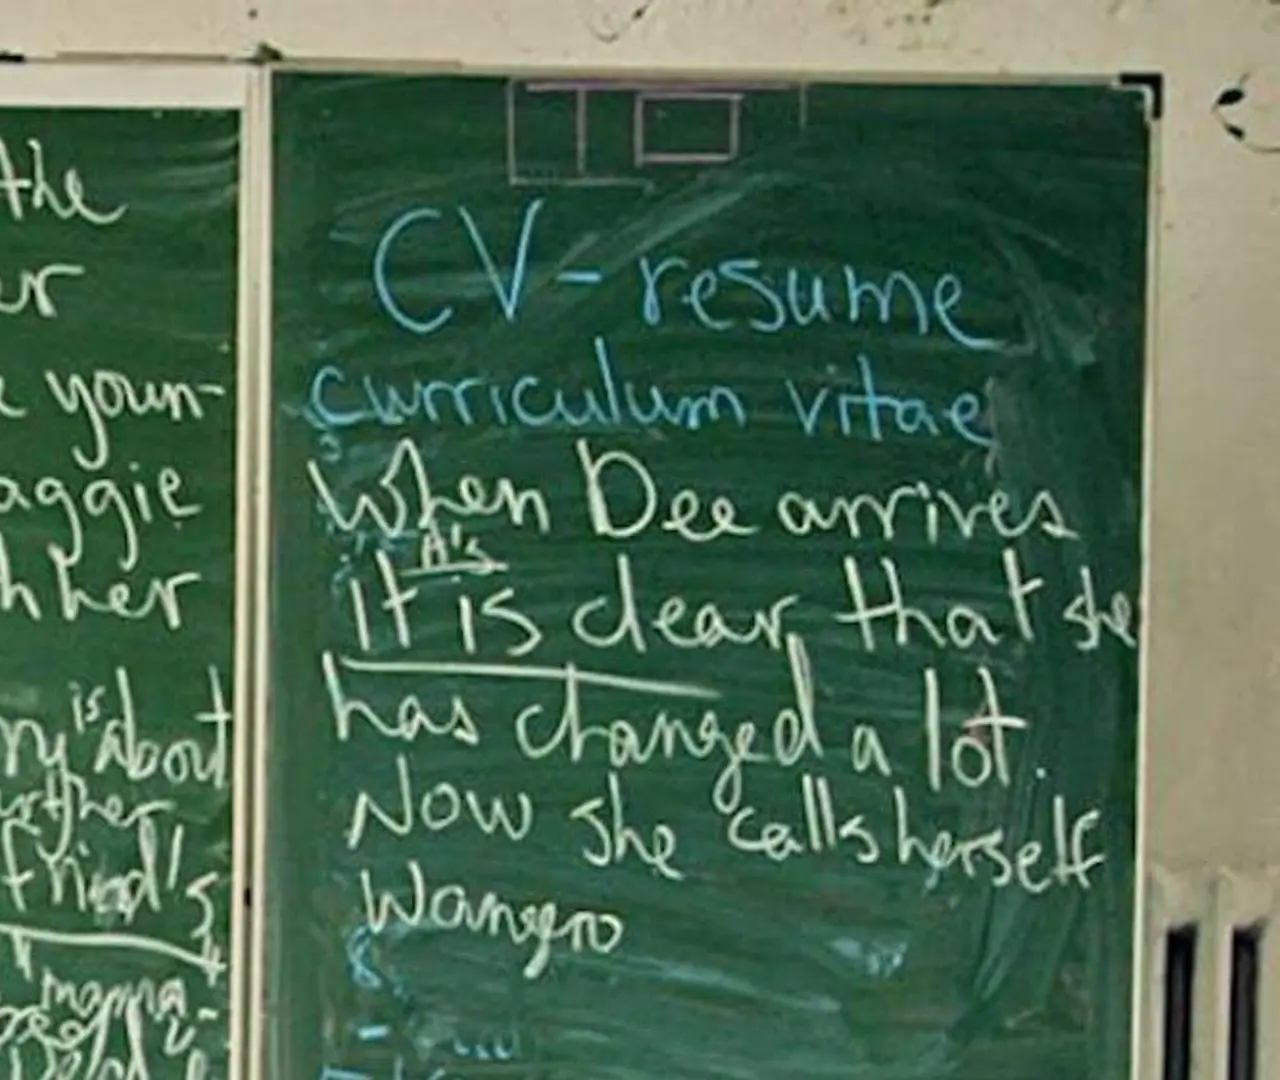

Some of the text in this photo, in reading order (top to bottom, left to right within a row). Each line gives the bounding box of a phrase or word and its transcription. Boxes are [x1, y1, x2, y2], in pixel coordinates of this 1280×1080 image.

[640, 252, 1018, 353] resume
[309, 338, 997, 448] curriculum vitae
[307, 437, 1082, 546] When Dee arrives
[52, 545, 203, 630] her
[454, 574, 544, 656] is
[574, 556, 800, 654] clear
[834, 549, 1046, 652] that
[94, 665, 234, 790] about
[322, 651, 481, 746] has
[516, 634, 826, 808] changed
[851, 724, 892, 776] a
[345, 756, 535, 850] Now
[727, 774, 880, 864] calls
[894, 786, 1105, 897] herself
